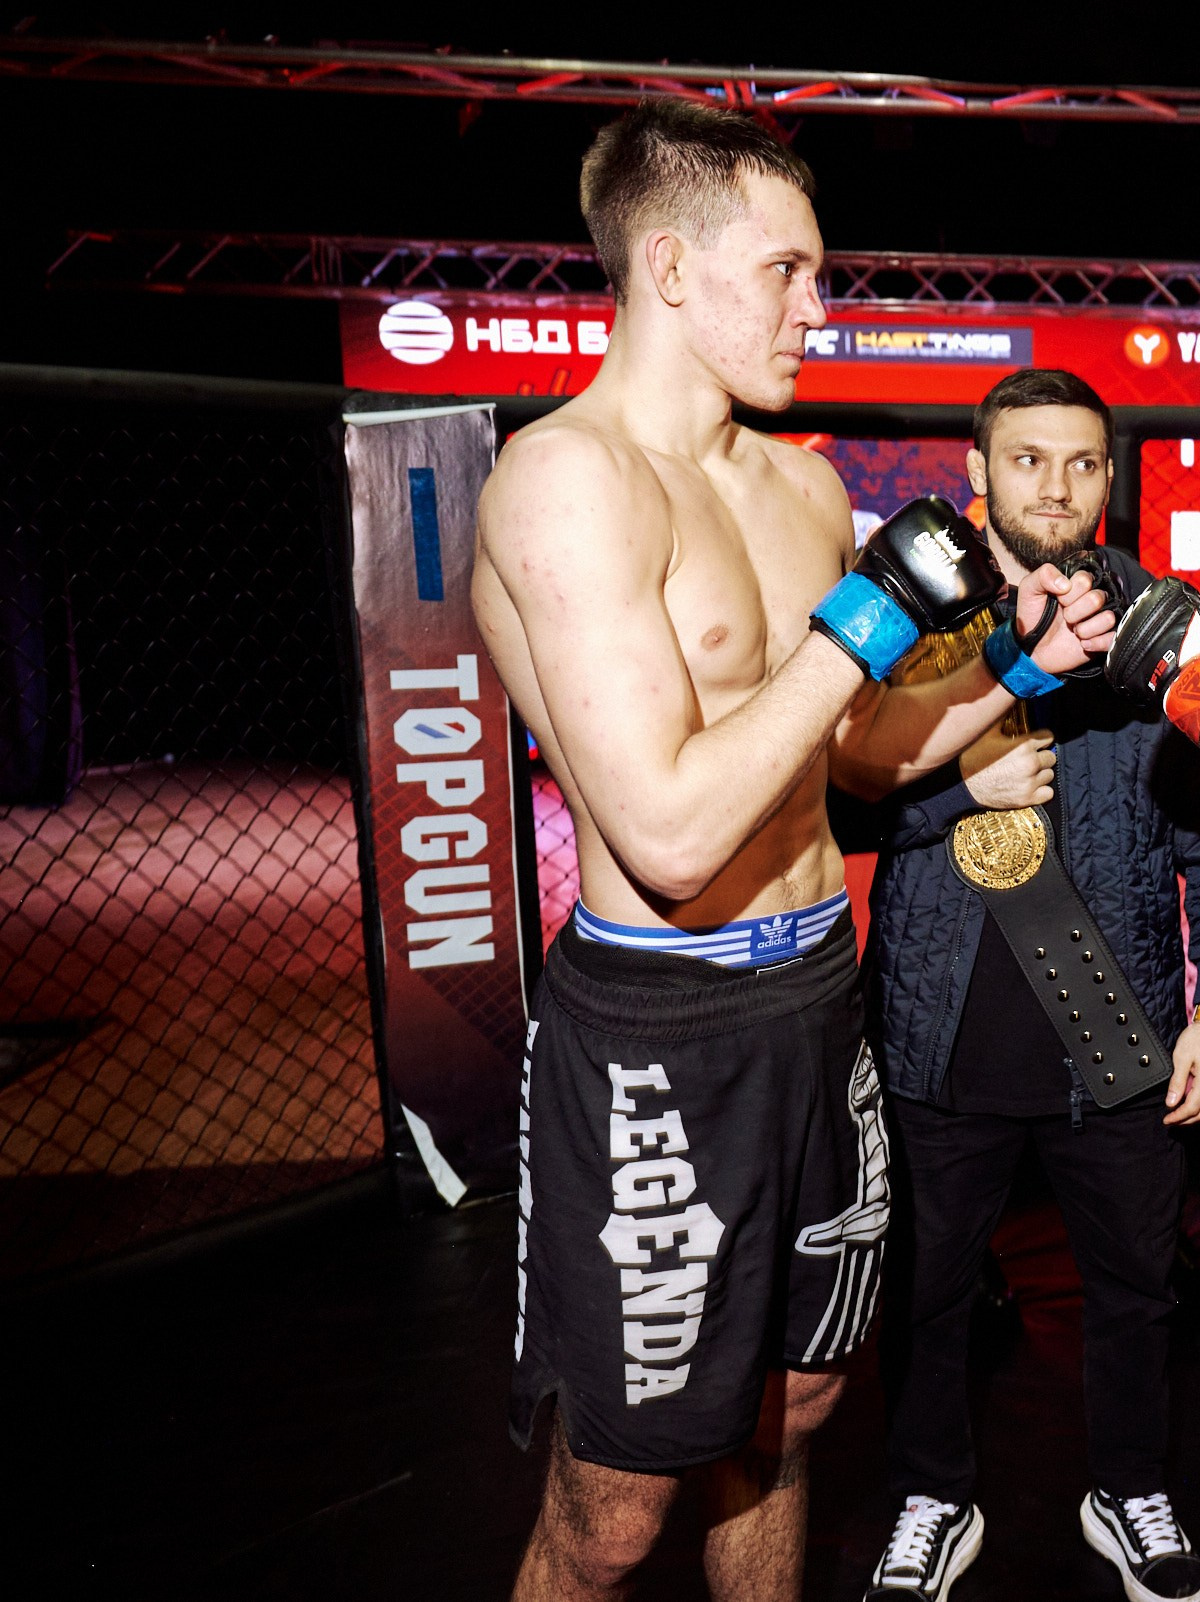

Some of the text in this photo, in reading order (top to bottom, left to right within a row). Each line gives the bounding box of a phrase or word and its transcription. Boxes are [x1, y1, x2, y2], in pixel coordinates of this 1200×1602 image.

[466, 318, 613, 354] НБД Б
[390, 653, 495, 969] TOPGUN
[757, 936, 792, 949] adidas
[598, 1063, 726, 1405] LEGENDA
